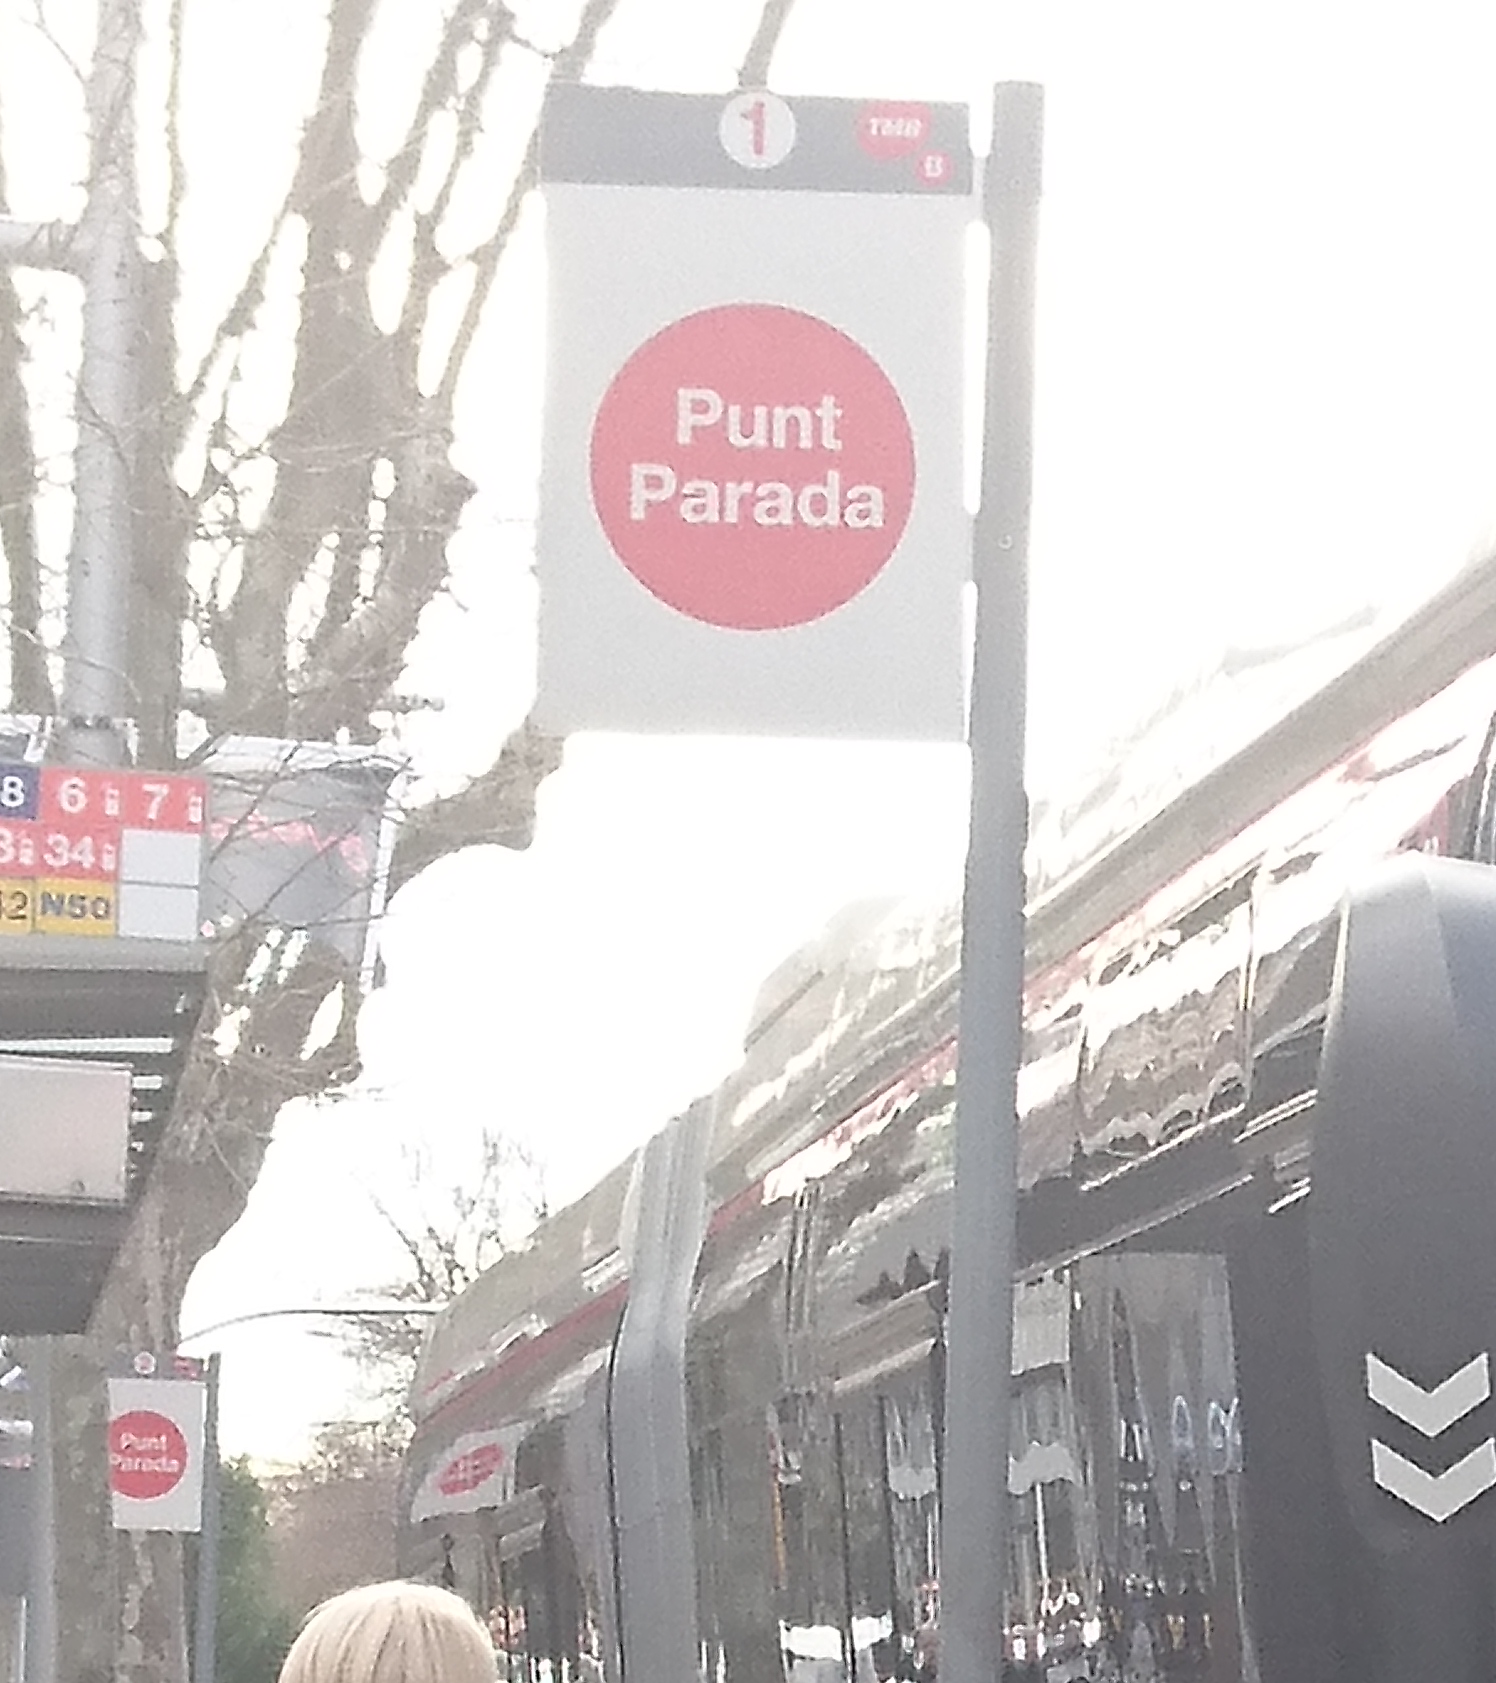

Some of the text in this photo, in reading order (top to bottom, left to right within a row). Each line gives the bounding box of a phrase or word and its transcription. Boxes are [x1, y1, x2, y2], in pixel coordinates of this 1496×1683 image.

[740, 100, 766, 157] 1
[676, 387, 844, 452] Punt
[629, 463, 885, 530] Parada
[59, 777, 88, 814] 6
[142, 784, 170, 820] 7
[42, 834, 96, 870] 34
[41, 890, 111, 921] N50
[119, 1432, 168, 1452] Punt
[109, 1454, 180, 1473] Parada
